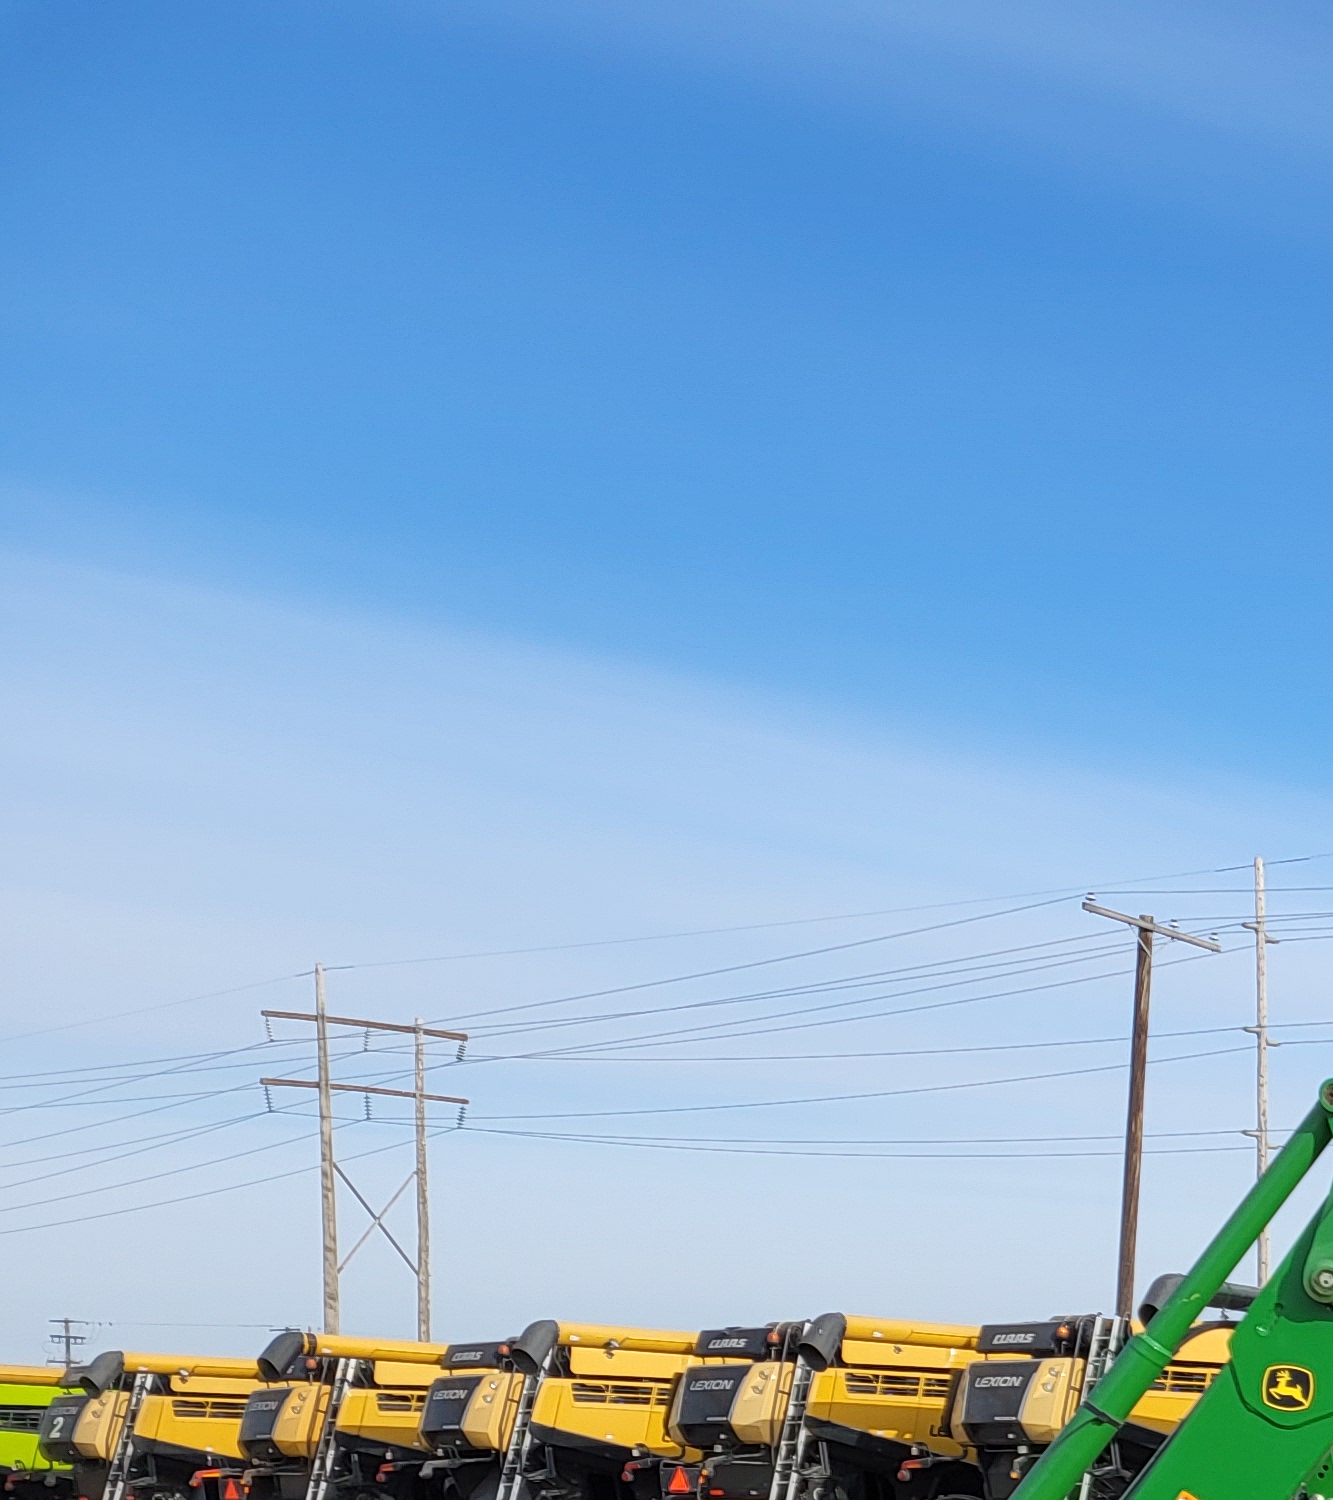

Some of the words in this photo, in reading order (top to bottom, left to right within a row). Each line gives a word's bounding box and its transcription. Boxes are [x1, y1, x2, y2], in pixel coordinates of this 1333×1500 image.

[707, 1338, 748, 1349] CLAAS
[991, 1333, 1036, 1345] CLAAS
[689, 1380, 734, 1391] LEXION
[974, 1376, 1023, 1388] LEXION
[49, 1416, 64, 1439] 2
